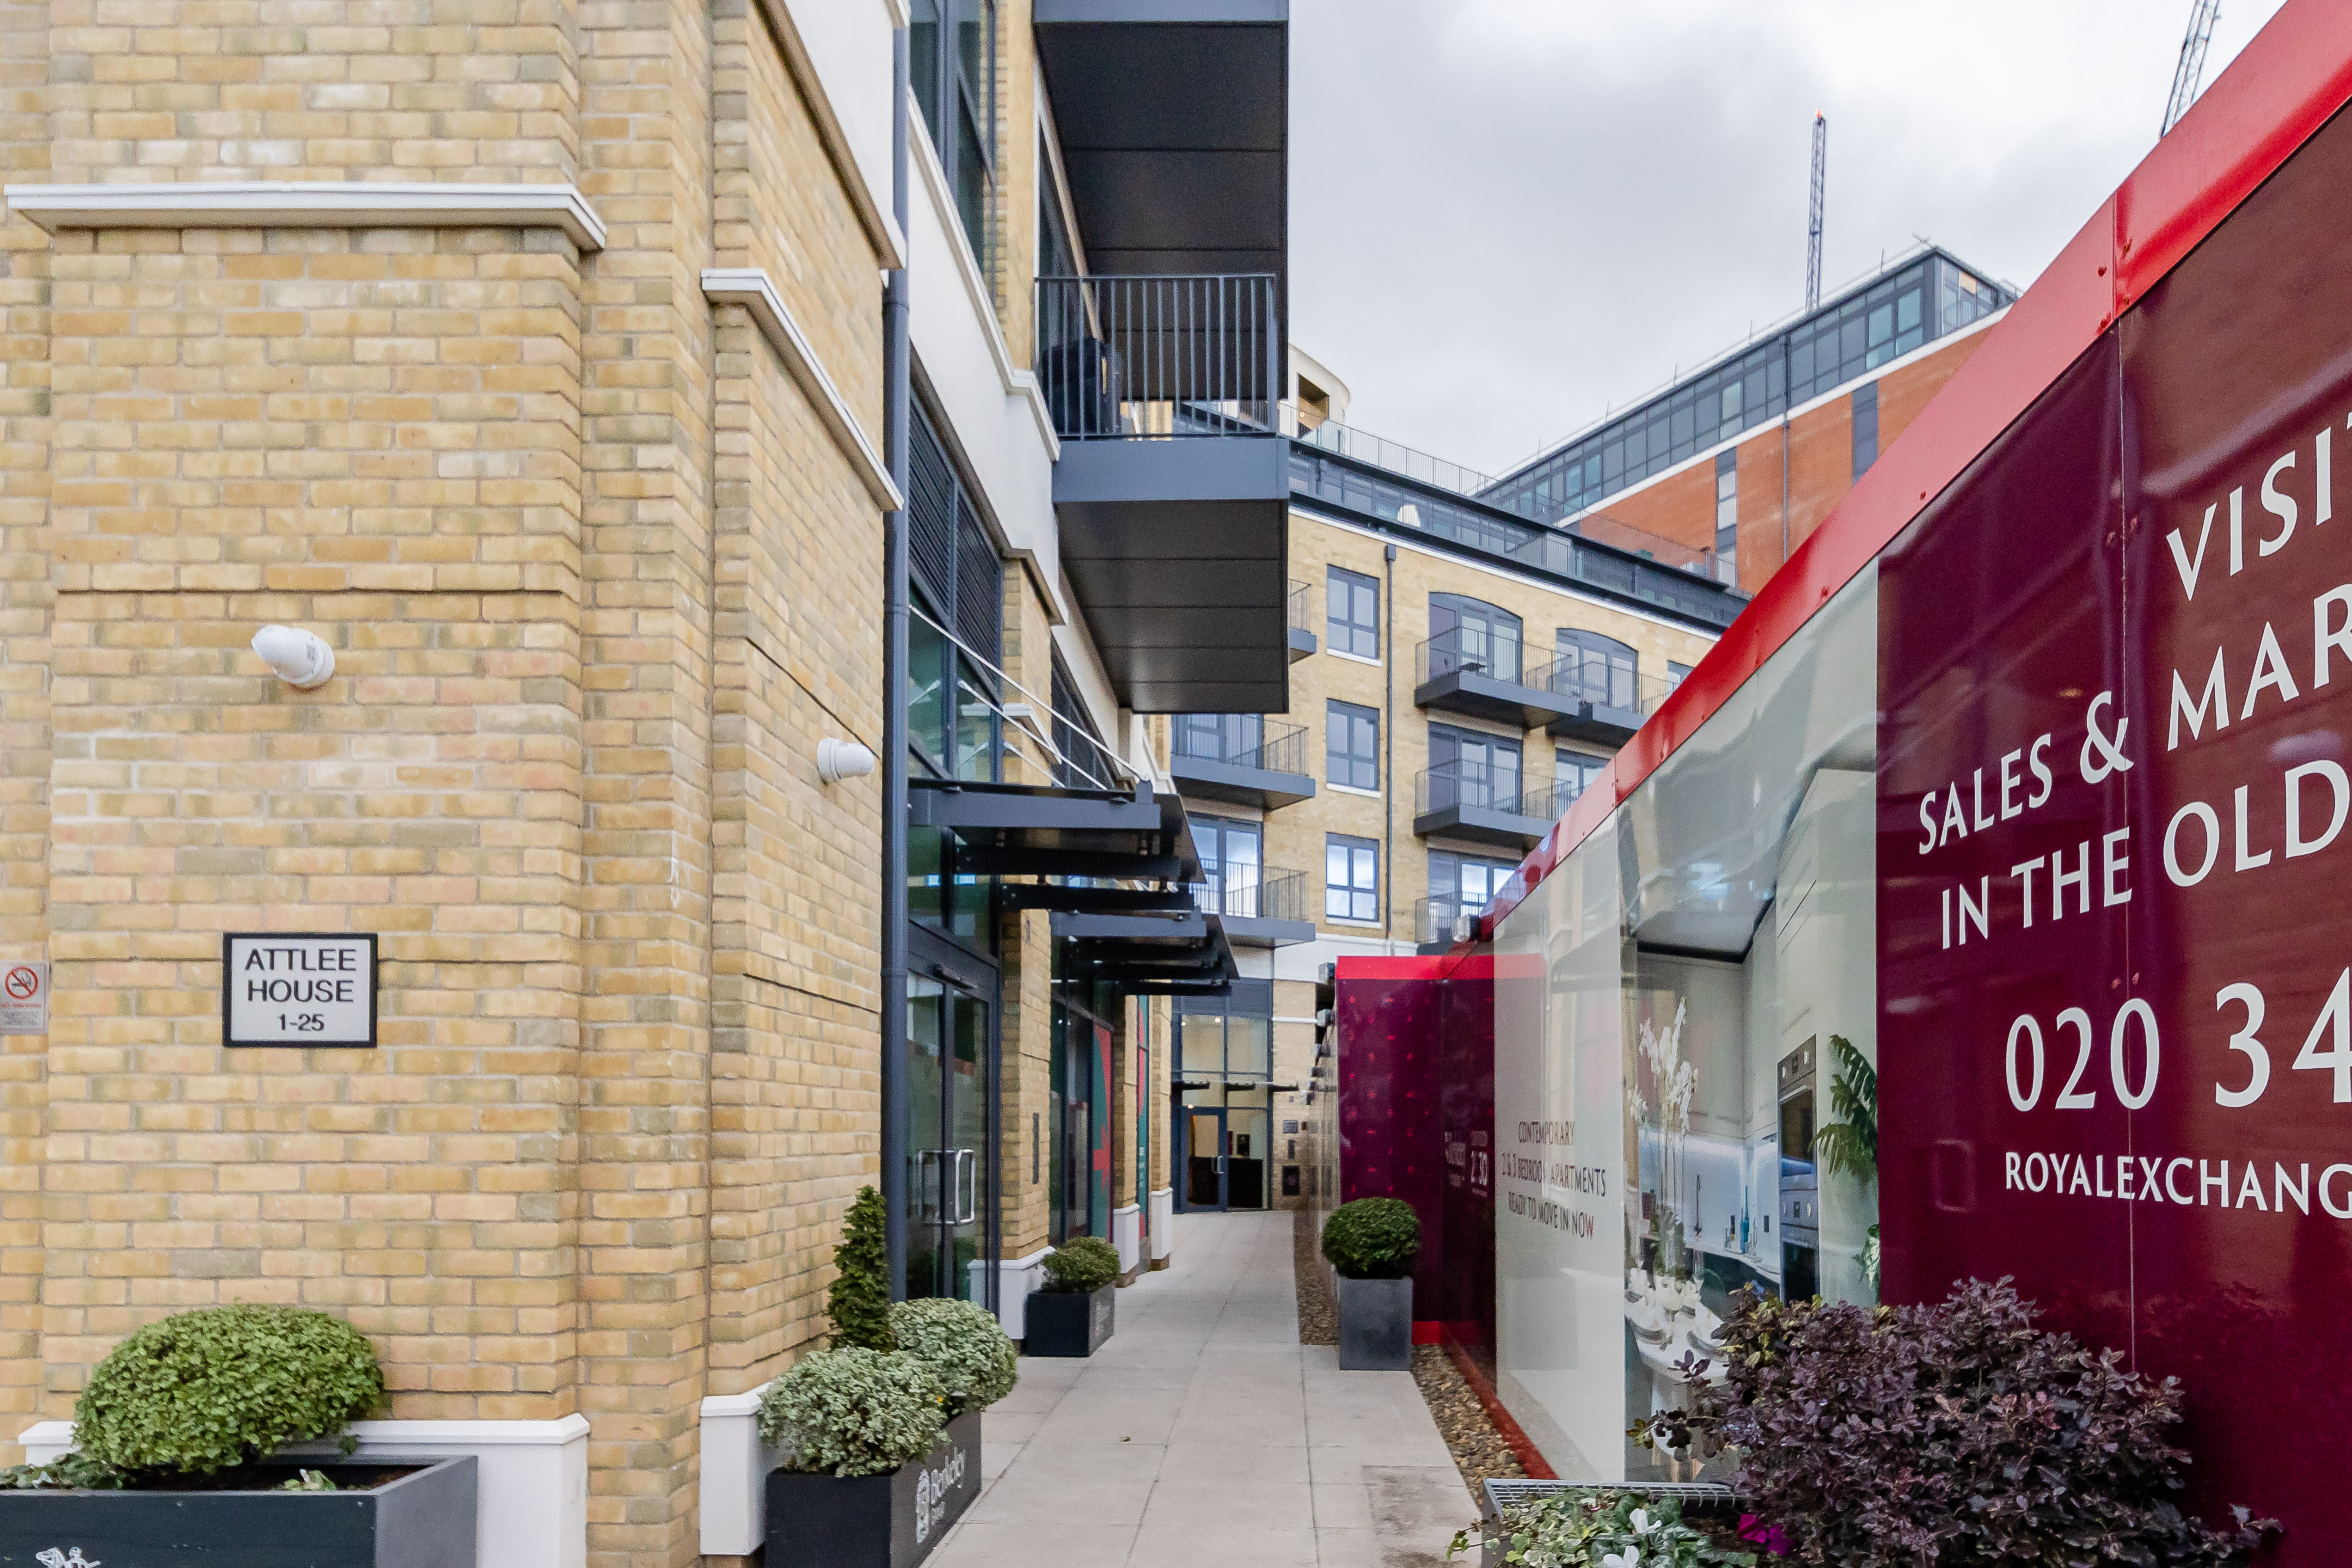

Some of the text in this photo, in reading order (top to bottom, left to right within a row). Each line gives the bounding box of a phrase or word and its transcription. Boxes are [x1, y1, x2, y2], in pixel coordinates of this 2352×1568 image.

[2166, 412, 2352, 601] VISI
[1919, 583, 2352, 854] SALES & MAR
[1942, 760, 2350, 949] IN THE OLD
[245, 949, 356, 971] ATTLEE
[248, 979, 354, 1003] HOUSE
[278, 1013, 324, 1032] 1-25
[2006, 967, 2352, 1112] 020 34
[1518, 1121, 1574, 1145] CONTEMPORARY
[1550, 1164, 1606, 1196] APARTMENTS
[2005, 1152, 2352, 1219] ROYALEXCHANG
[1527, 1196, 1536, 1219] TO
[1538, 1202, 1558, 1228] MOVE
[1560, 1207, 1569, 1231] IN
[1572, 1210, 1594, 1239] NOW
